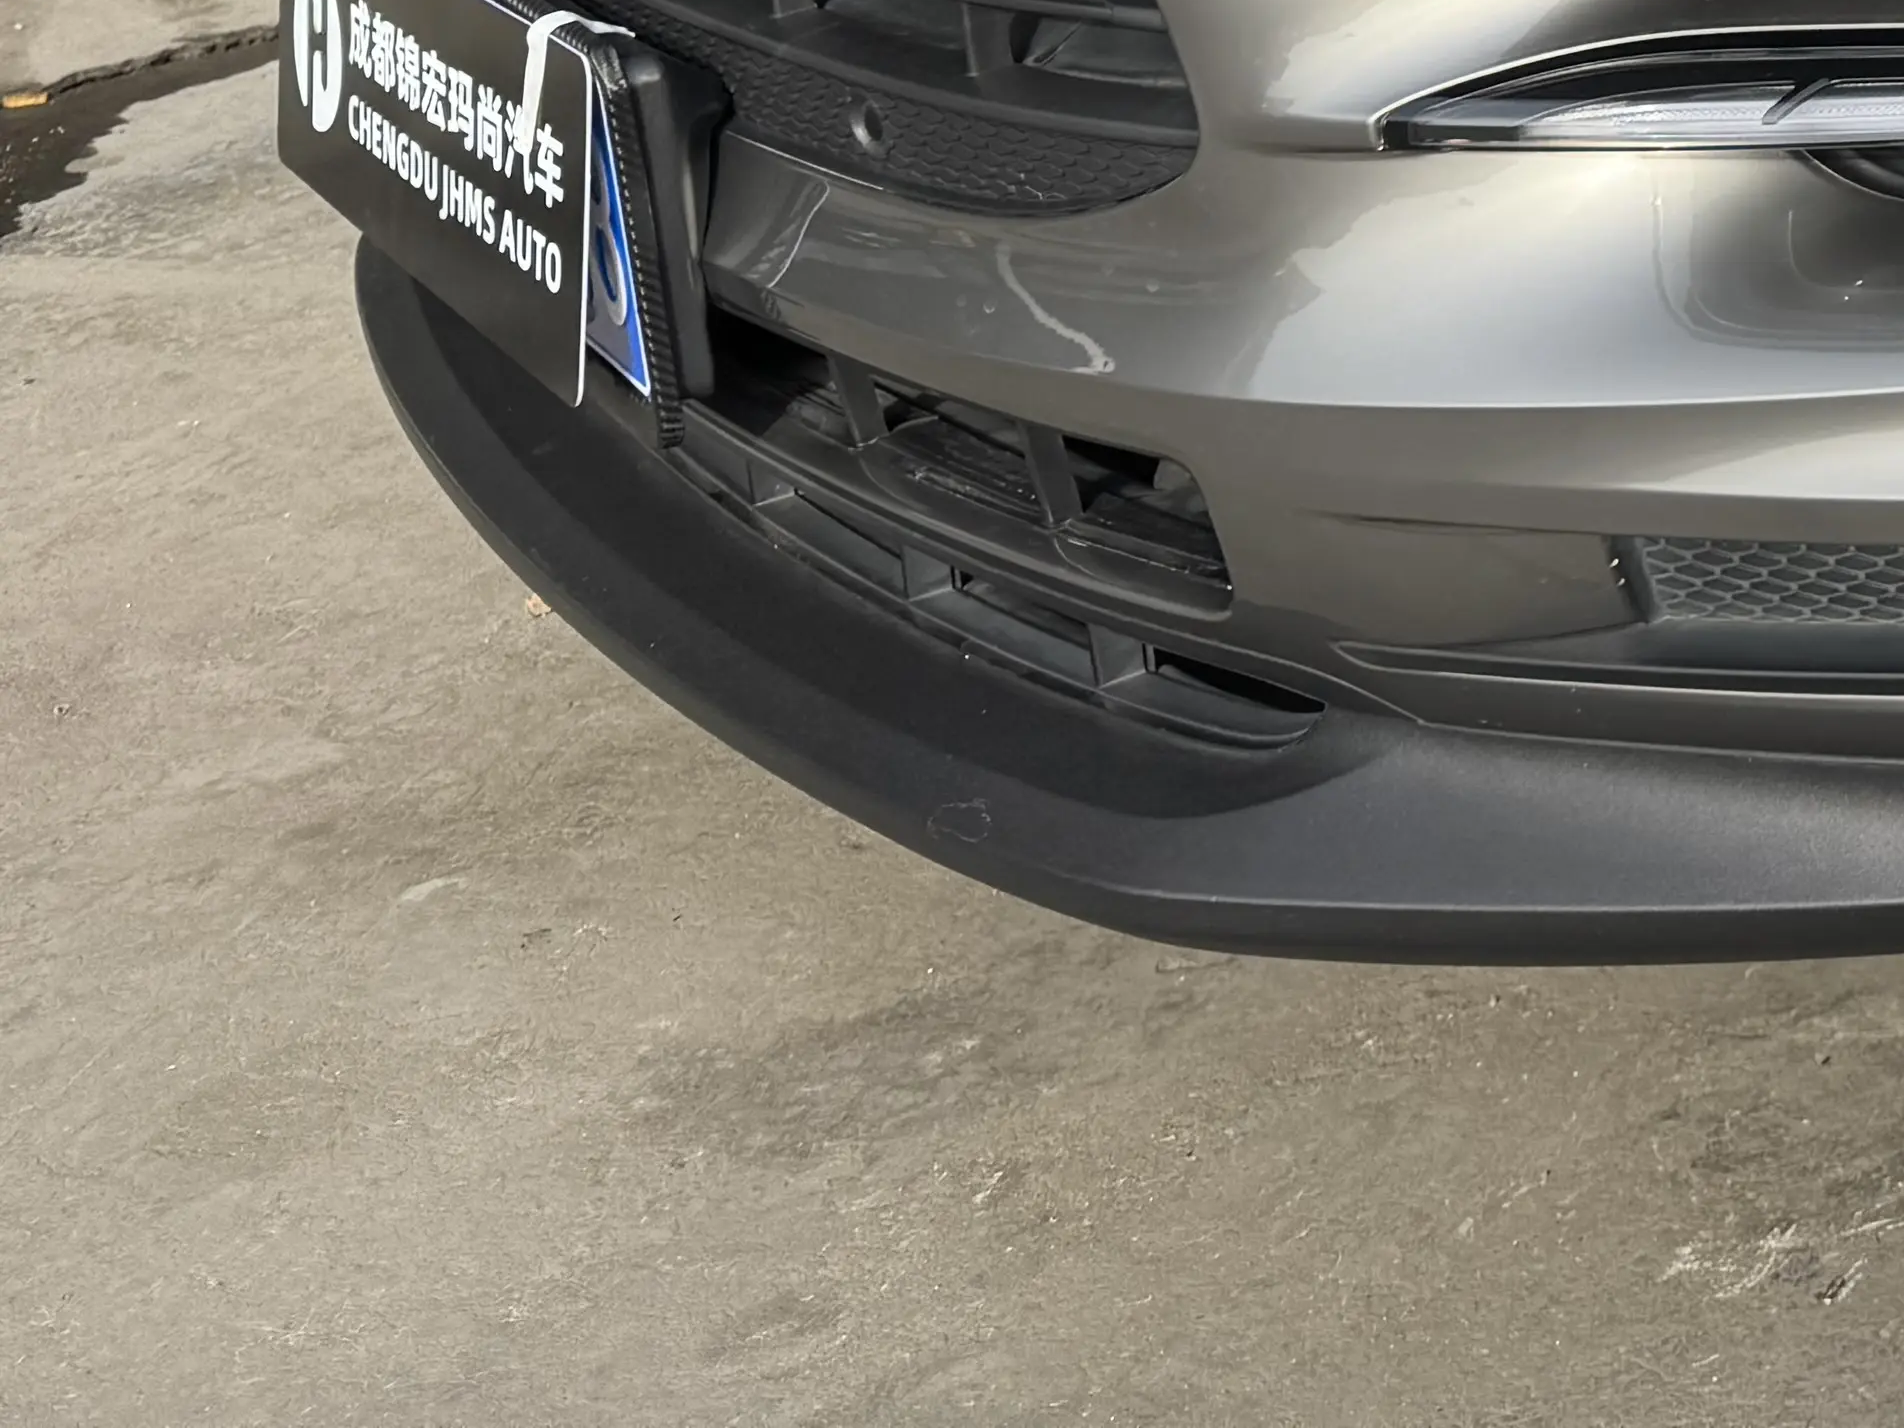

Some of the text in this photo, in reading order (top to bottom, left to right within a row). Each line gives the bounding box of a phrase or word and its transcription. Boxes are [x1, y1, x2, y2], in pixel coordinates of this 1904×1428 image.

[348, 94, 563, 295] CHENGDU JHMS AUTO
